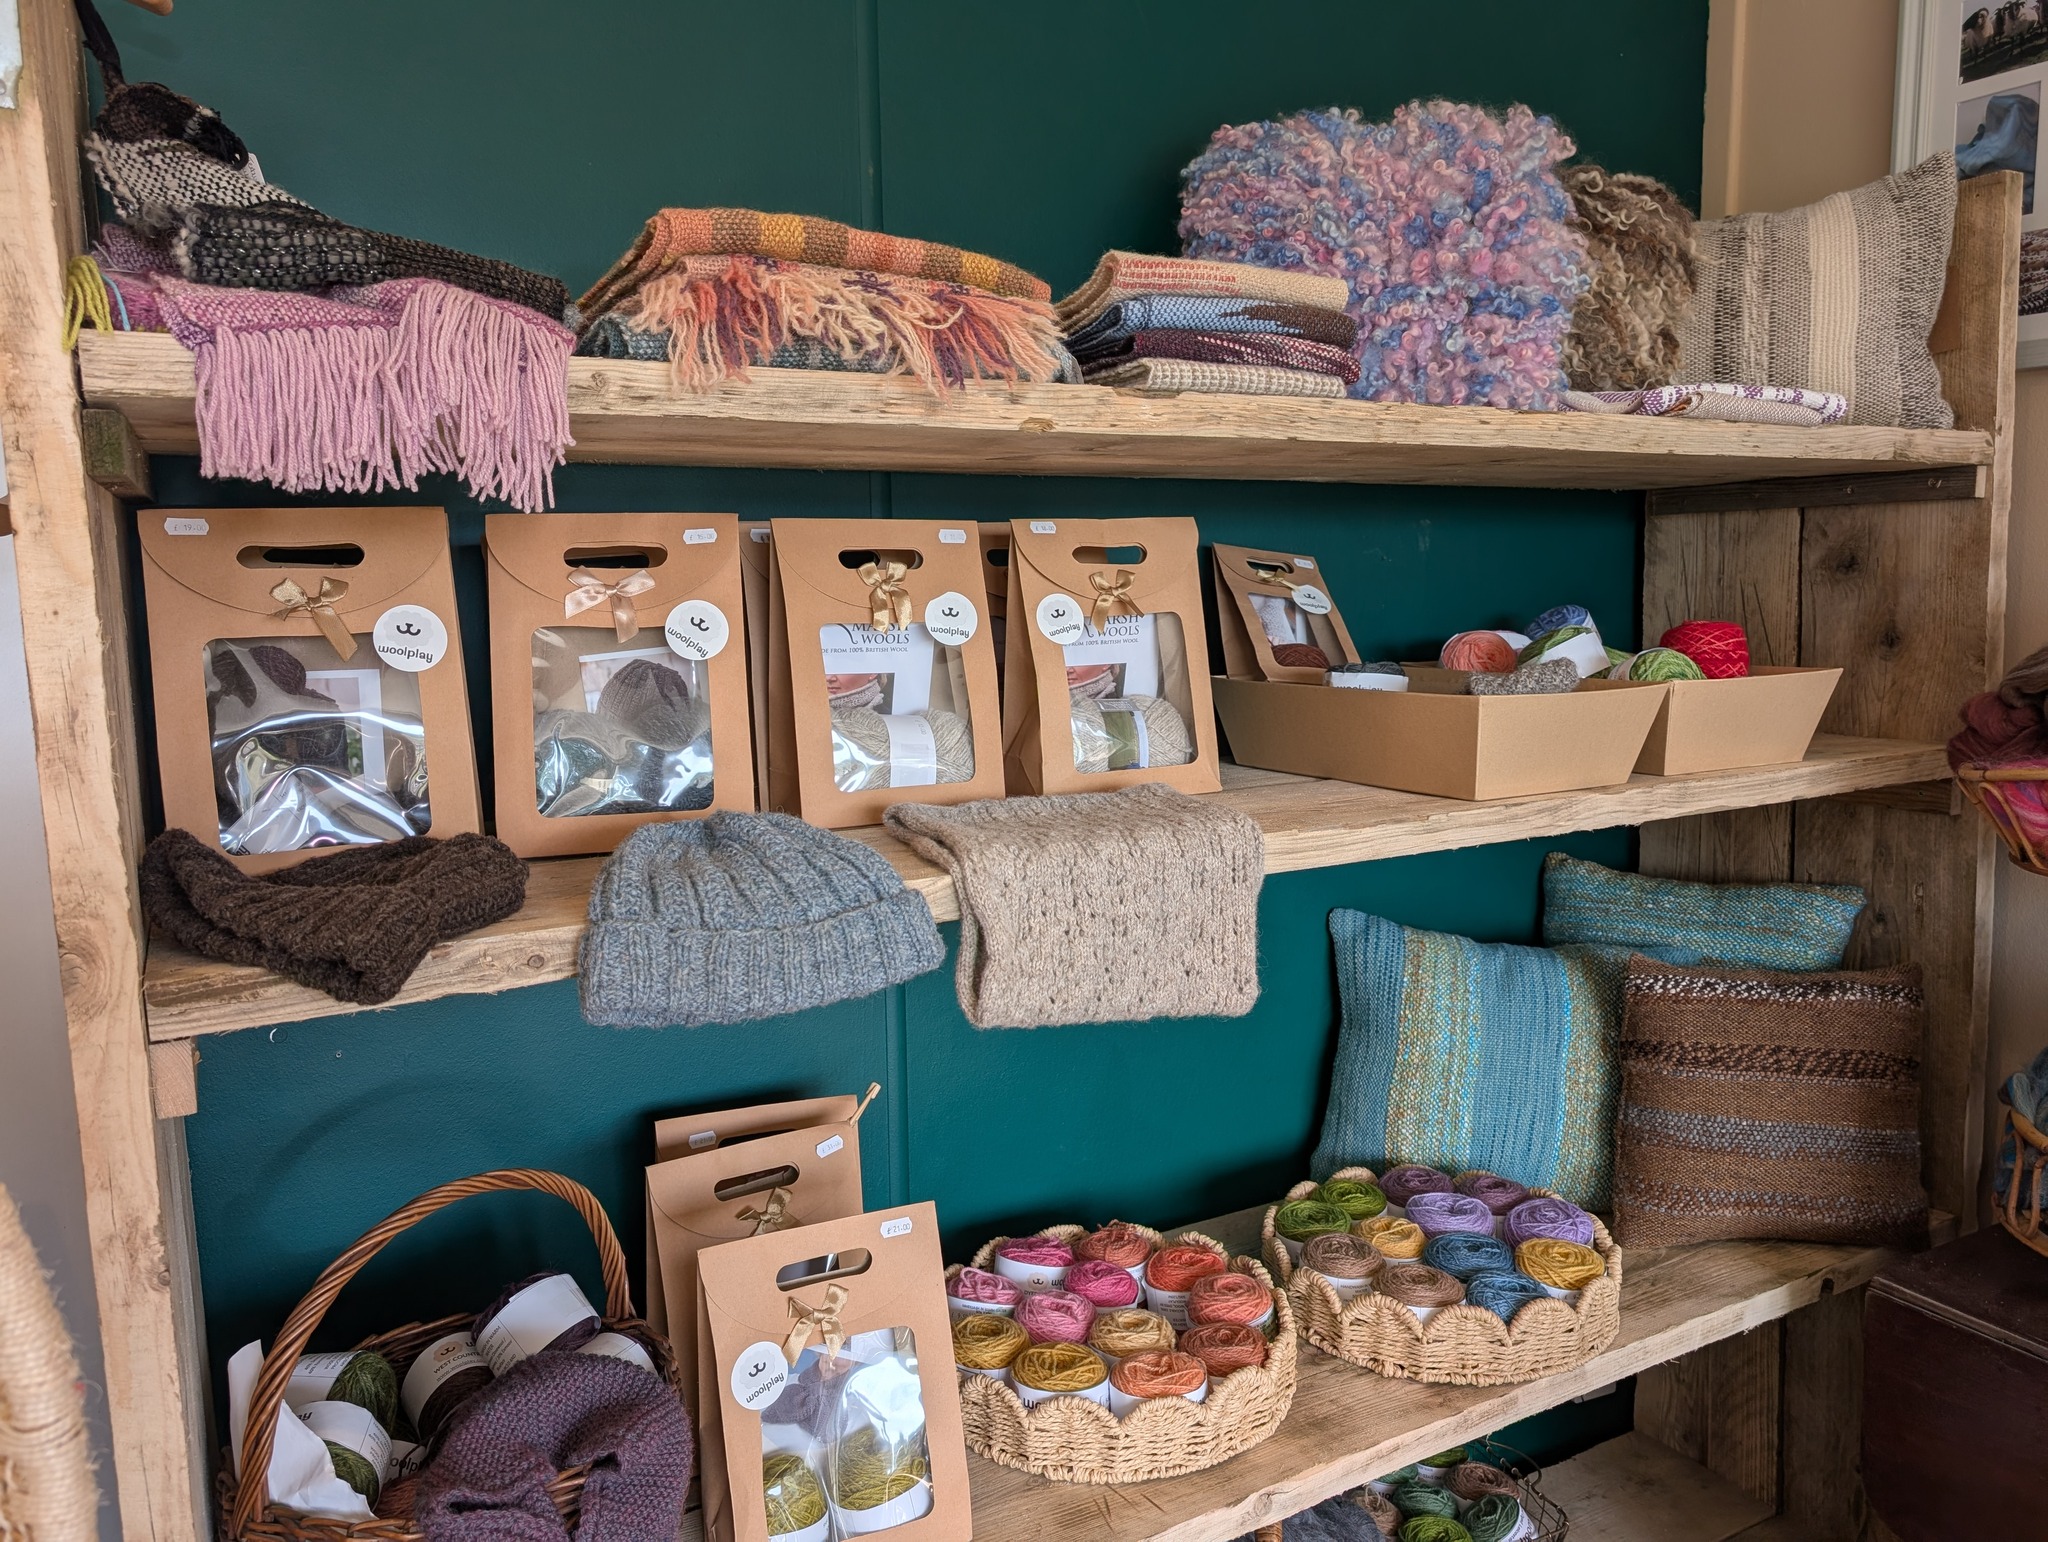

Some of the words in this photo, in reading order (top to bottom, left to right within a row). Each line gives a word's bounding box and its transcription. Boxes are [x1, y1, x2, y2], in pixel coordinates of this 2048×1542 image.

[931, 626, 970, 638] woolplay
[1049, 623, 1081, 636] woolplay
[1098, 625, 1140, 637] WOOLS
[667, 617, 708, 658] woolplay
[862, 633, 910, 644] WOOLS
[378, 645, 433, 663] woolplay
[887, 1227, 891, 1235] £
[892, 1222, 911, 1233] 21.00
[433, 1359, 452, 1374] WEST
[745, 1372, 785, 1403] woolplay
